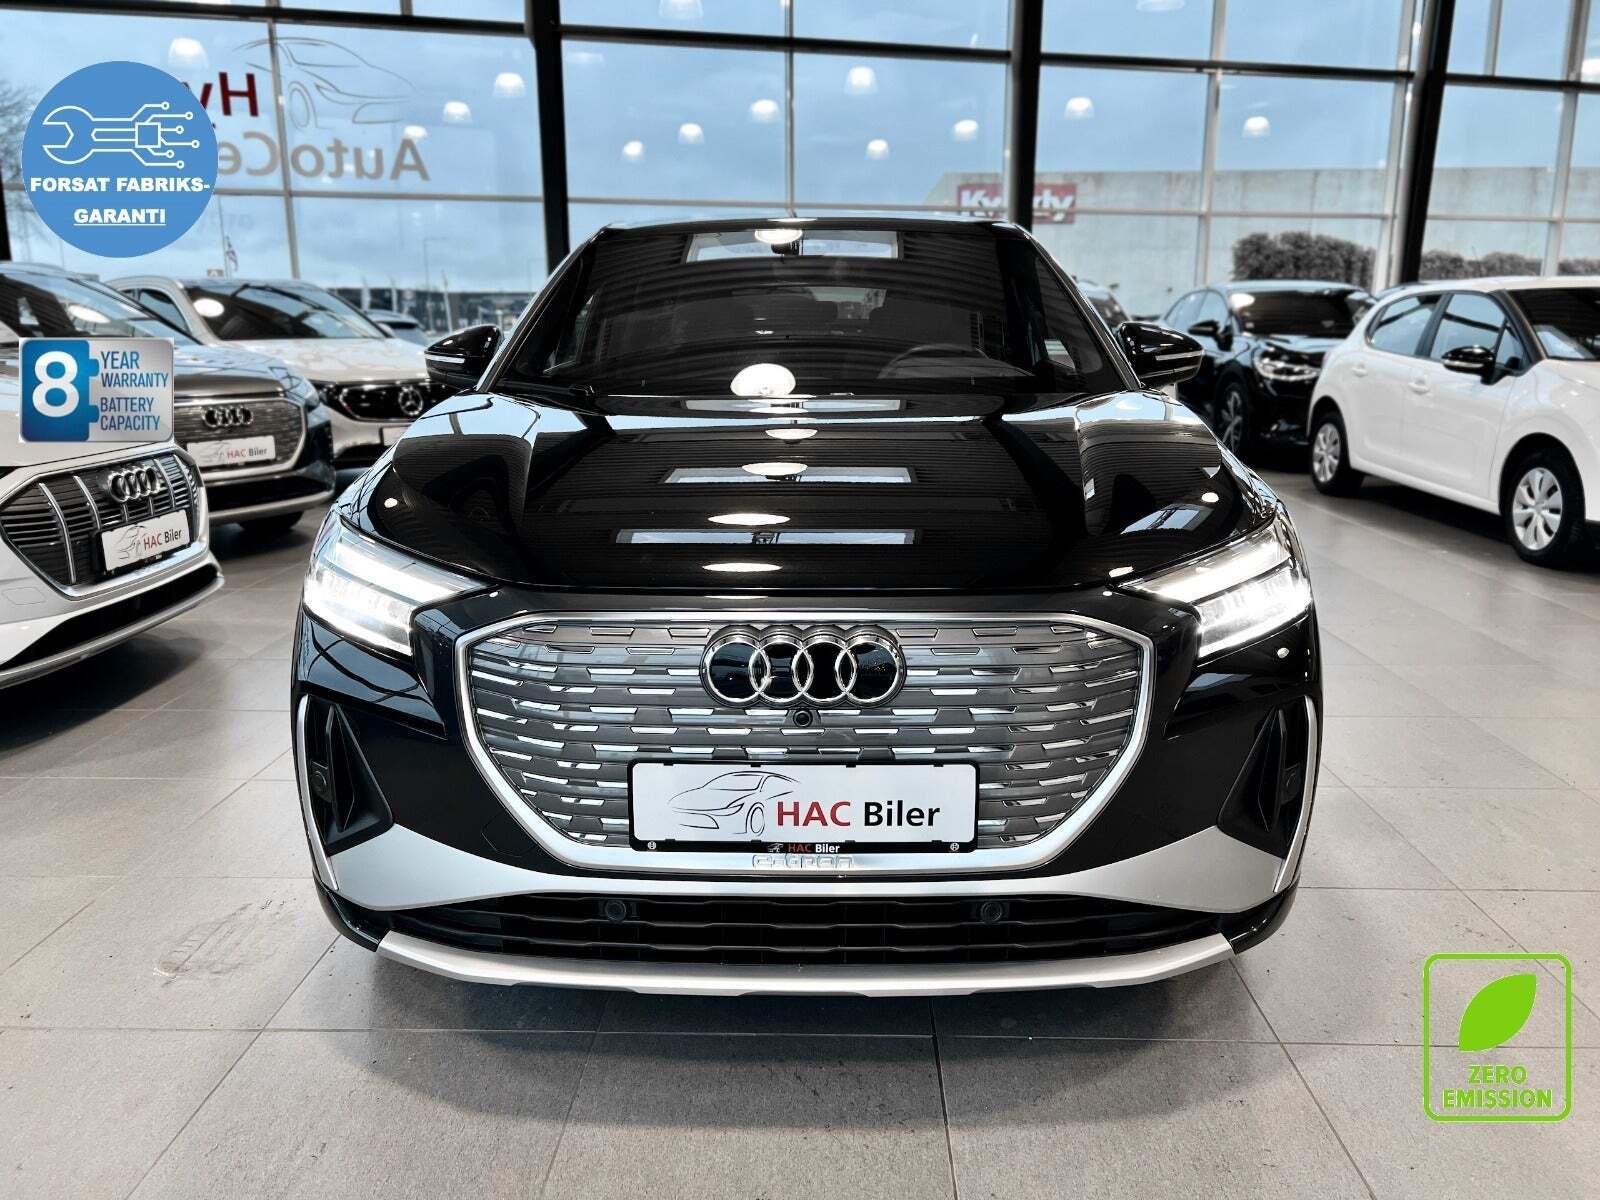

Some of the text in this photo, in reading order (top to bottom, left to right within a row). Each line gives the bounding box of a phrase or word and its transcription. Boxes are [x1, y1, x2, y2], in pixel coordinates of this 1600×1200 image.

[226, 447, 267, 459] HAC Biler
[143, 528, 182, 550] HAC Biler
[776, 800, 941, 828] HAC Biler
[787, 843, 841, 853] HAC Biler
